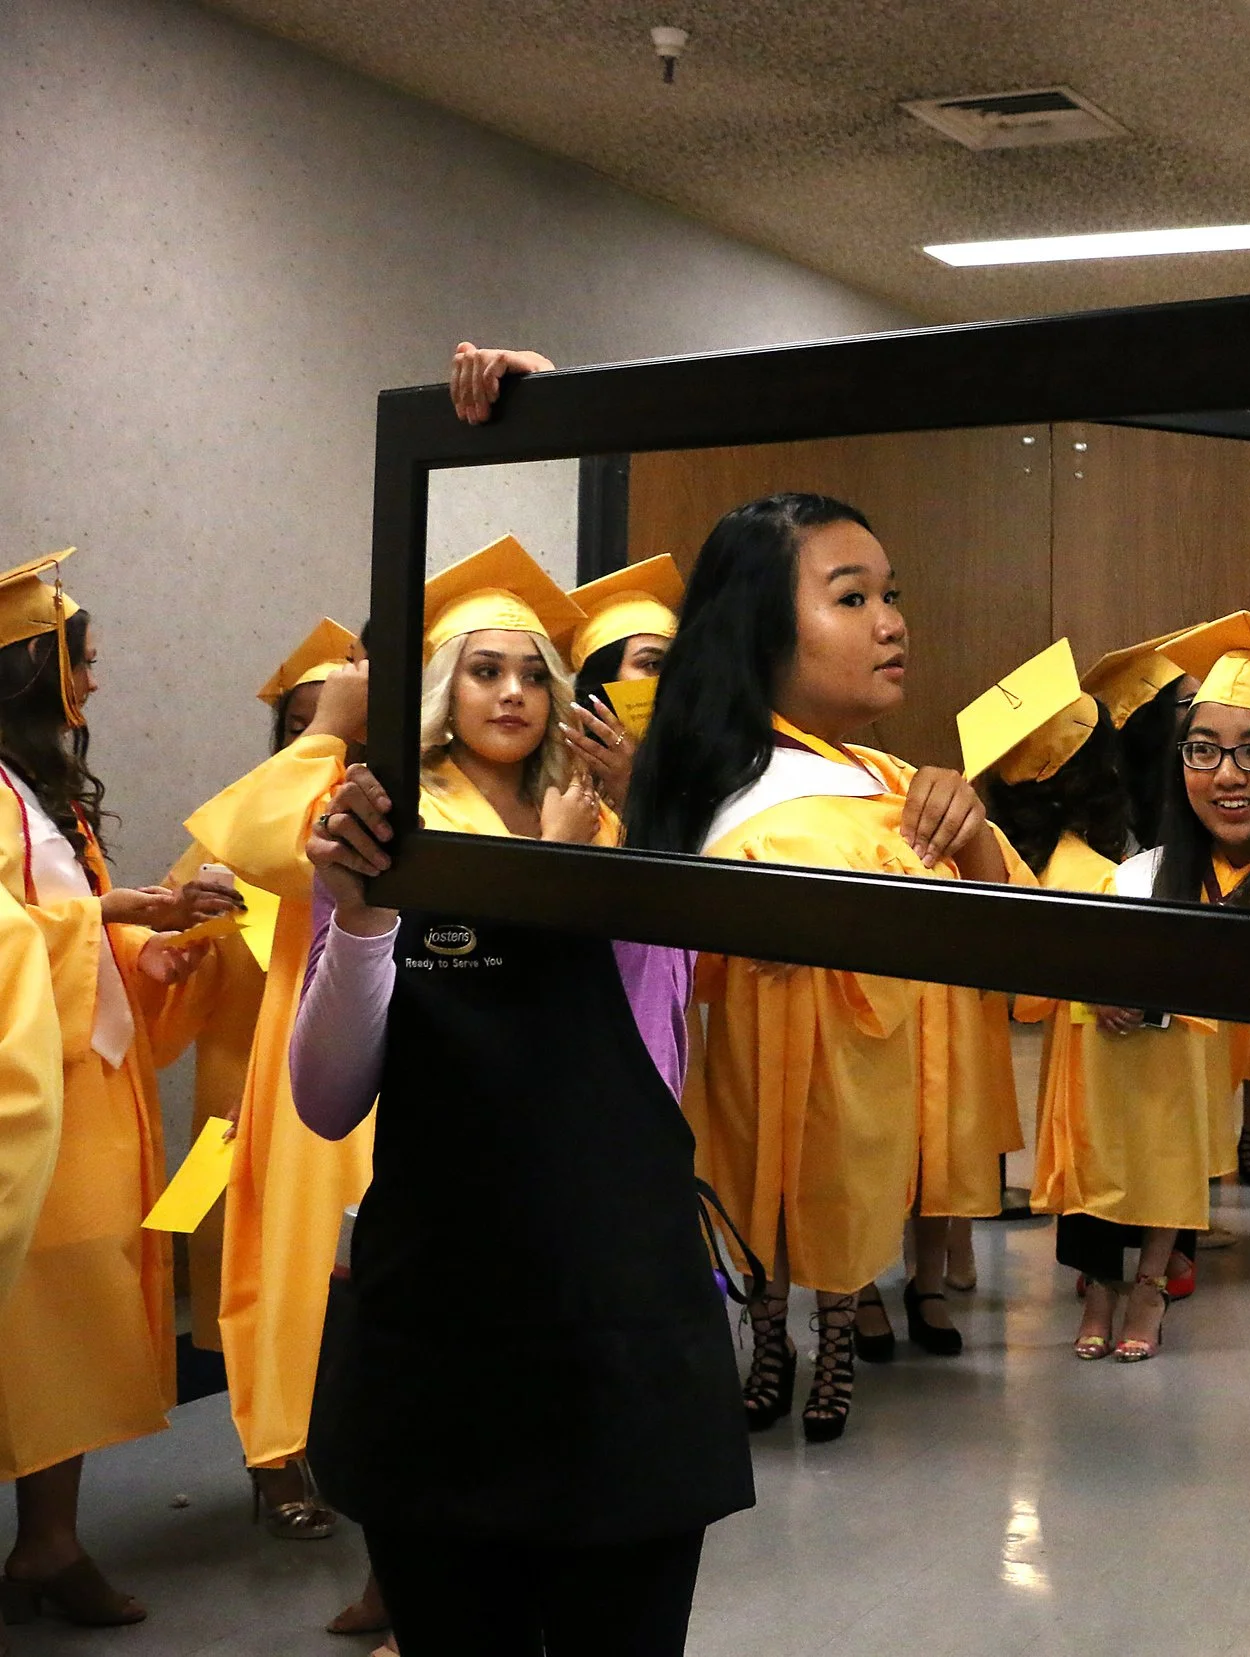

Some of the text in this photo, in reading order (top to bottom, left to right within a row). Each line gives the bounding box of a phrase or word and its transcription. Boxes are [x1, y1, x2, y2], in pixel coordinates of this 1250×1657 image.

[428, 928, 469, 946] jostens
[405, 956, 503, 970] Ready to Serve You
